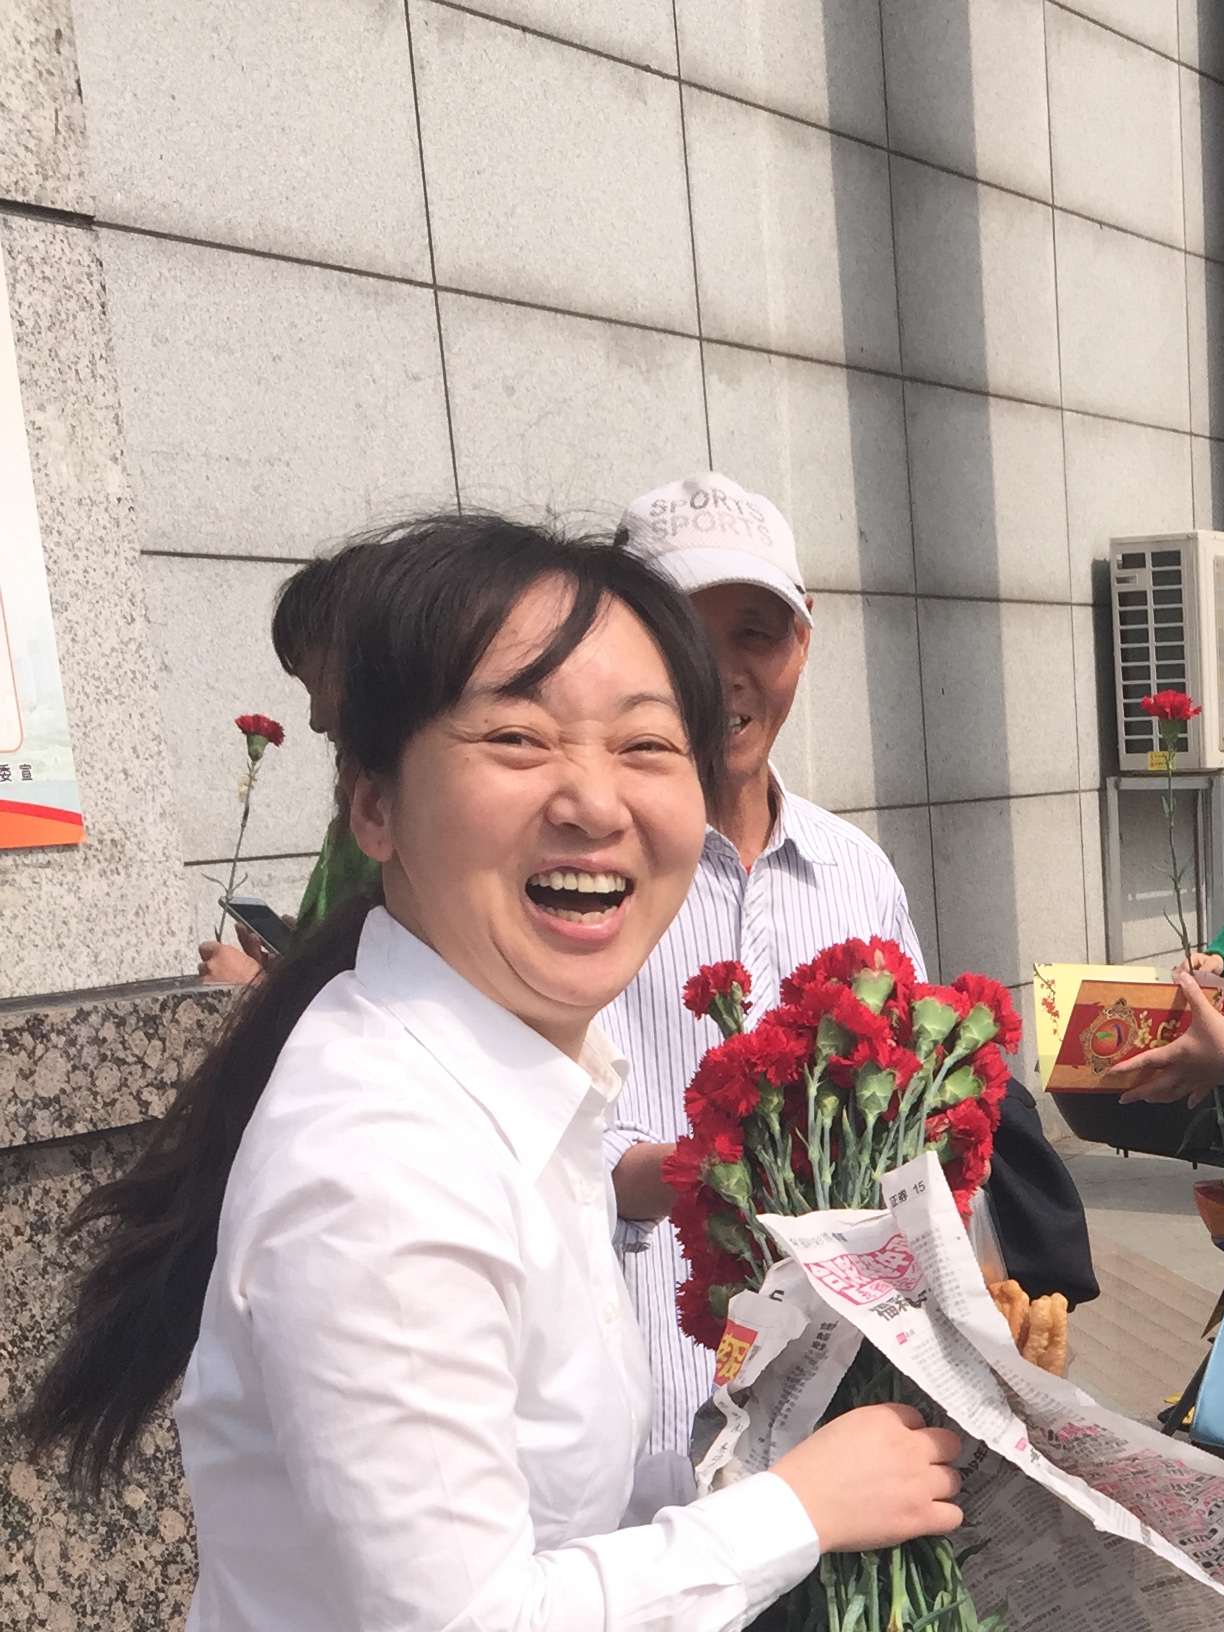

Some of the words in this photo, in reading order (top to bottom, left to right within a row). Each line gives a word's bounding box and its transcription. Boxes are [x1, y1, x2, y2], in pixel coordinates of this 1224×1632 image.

[650, 487, 766, 524] SPORTS
[651, 511, 773, 547] SPORTS
[912, 1180, 927, 1195] 15
